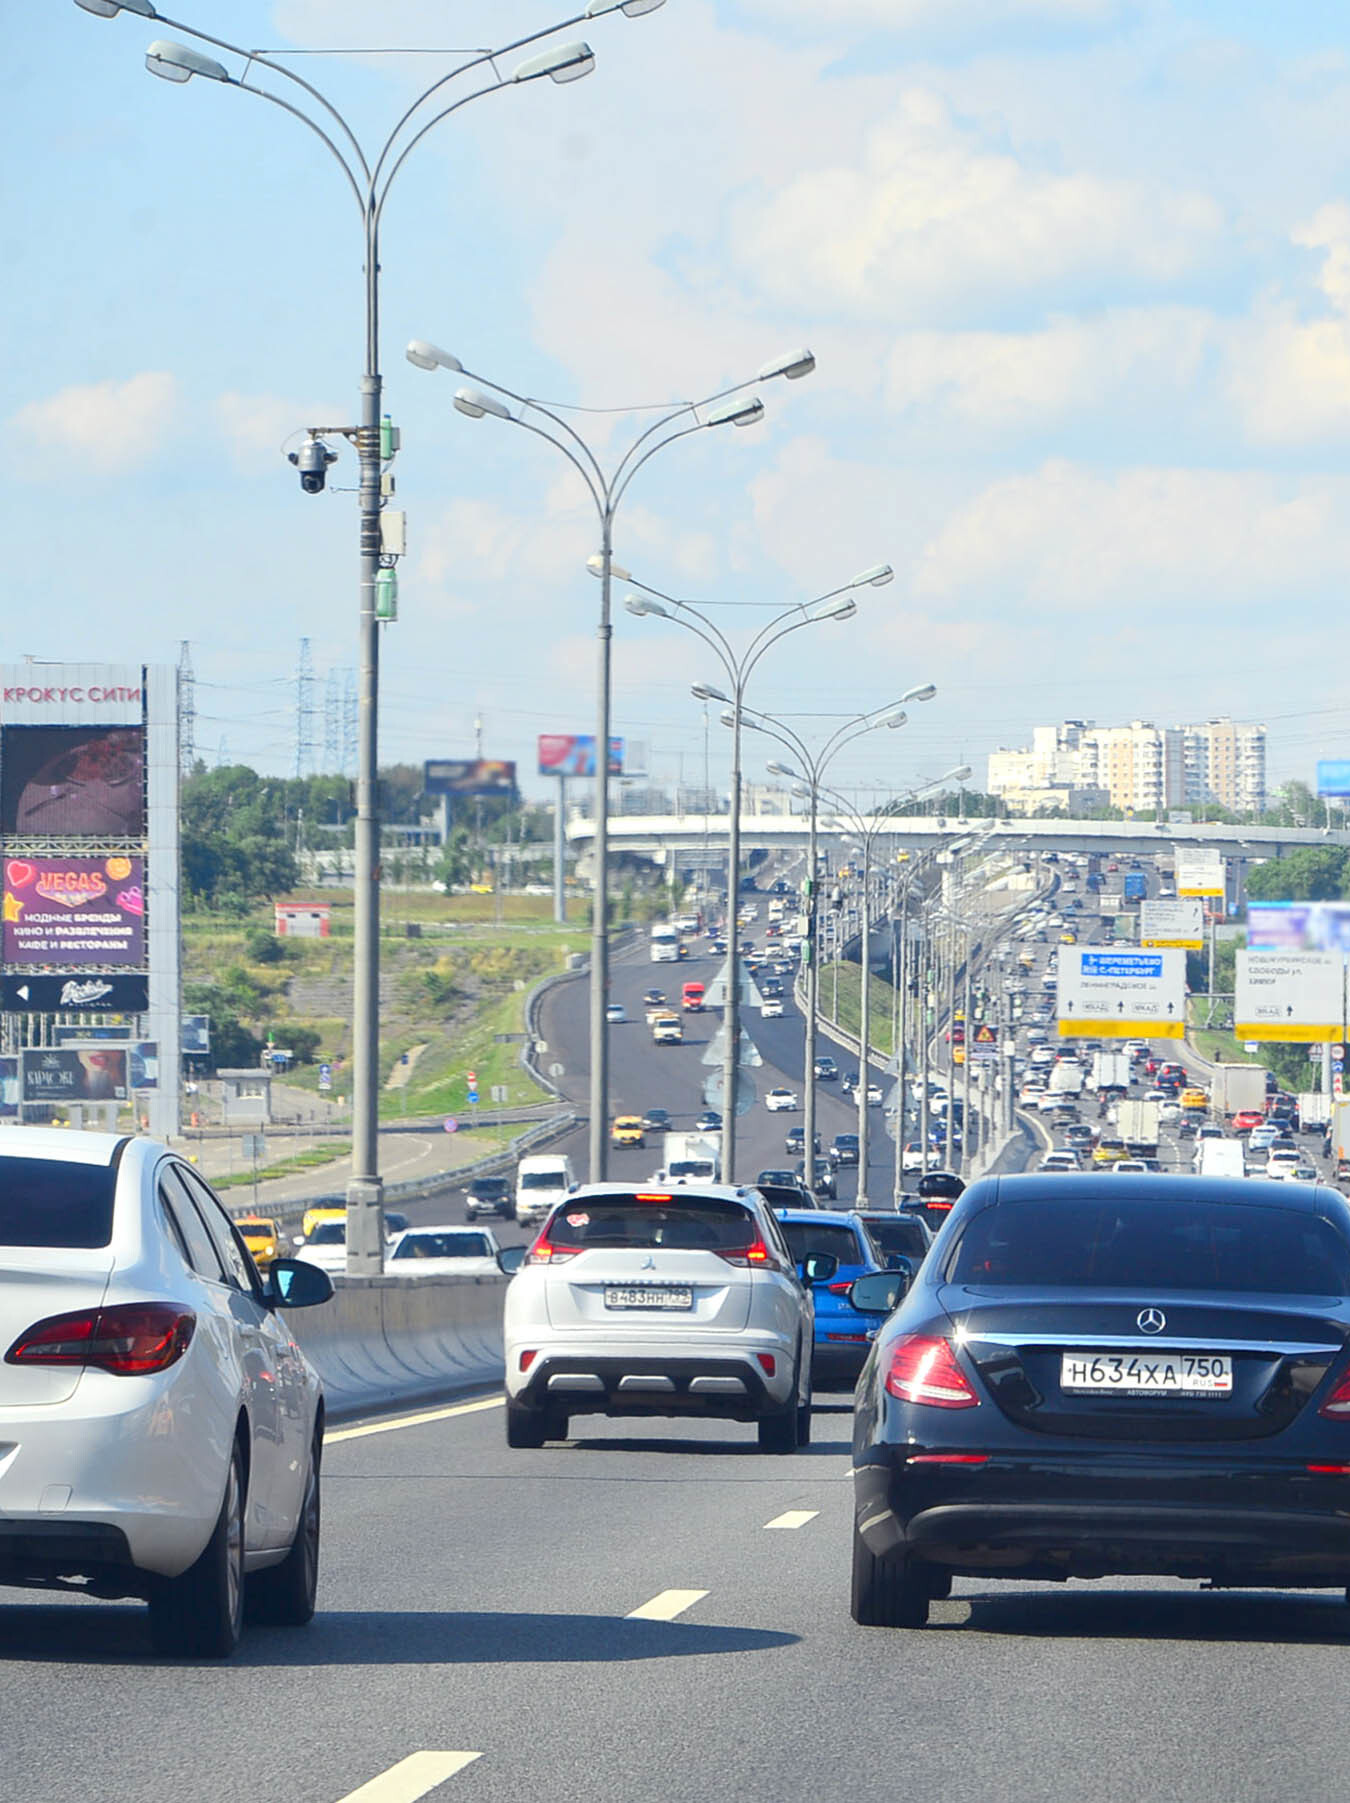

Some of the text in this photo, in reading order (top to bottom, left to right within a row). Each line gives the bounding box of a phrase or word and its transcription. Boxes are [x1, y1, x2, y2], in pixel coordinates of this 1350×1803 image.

[4, 687, 140, 702] КРОКУС СИТИ
[40, 871, 103, 890] VEGAS
[25, 914, 122, 923] МОДНЫЕ БРЕНДЫ
[14, 927, 133, 936] КИНО И РАЗВЛЕЧЕНИЯ
[19, 941, 128, 950] КАФЕ И РЕСТОРАНЫ
[1072, 1358, 1224, 1384] Н634ХА 750
